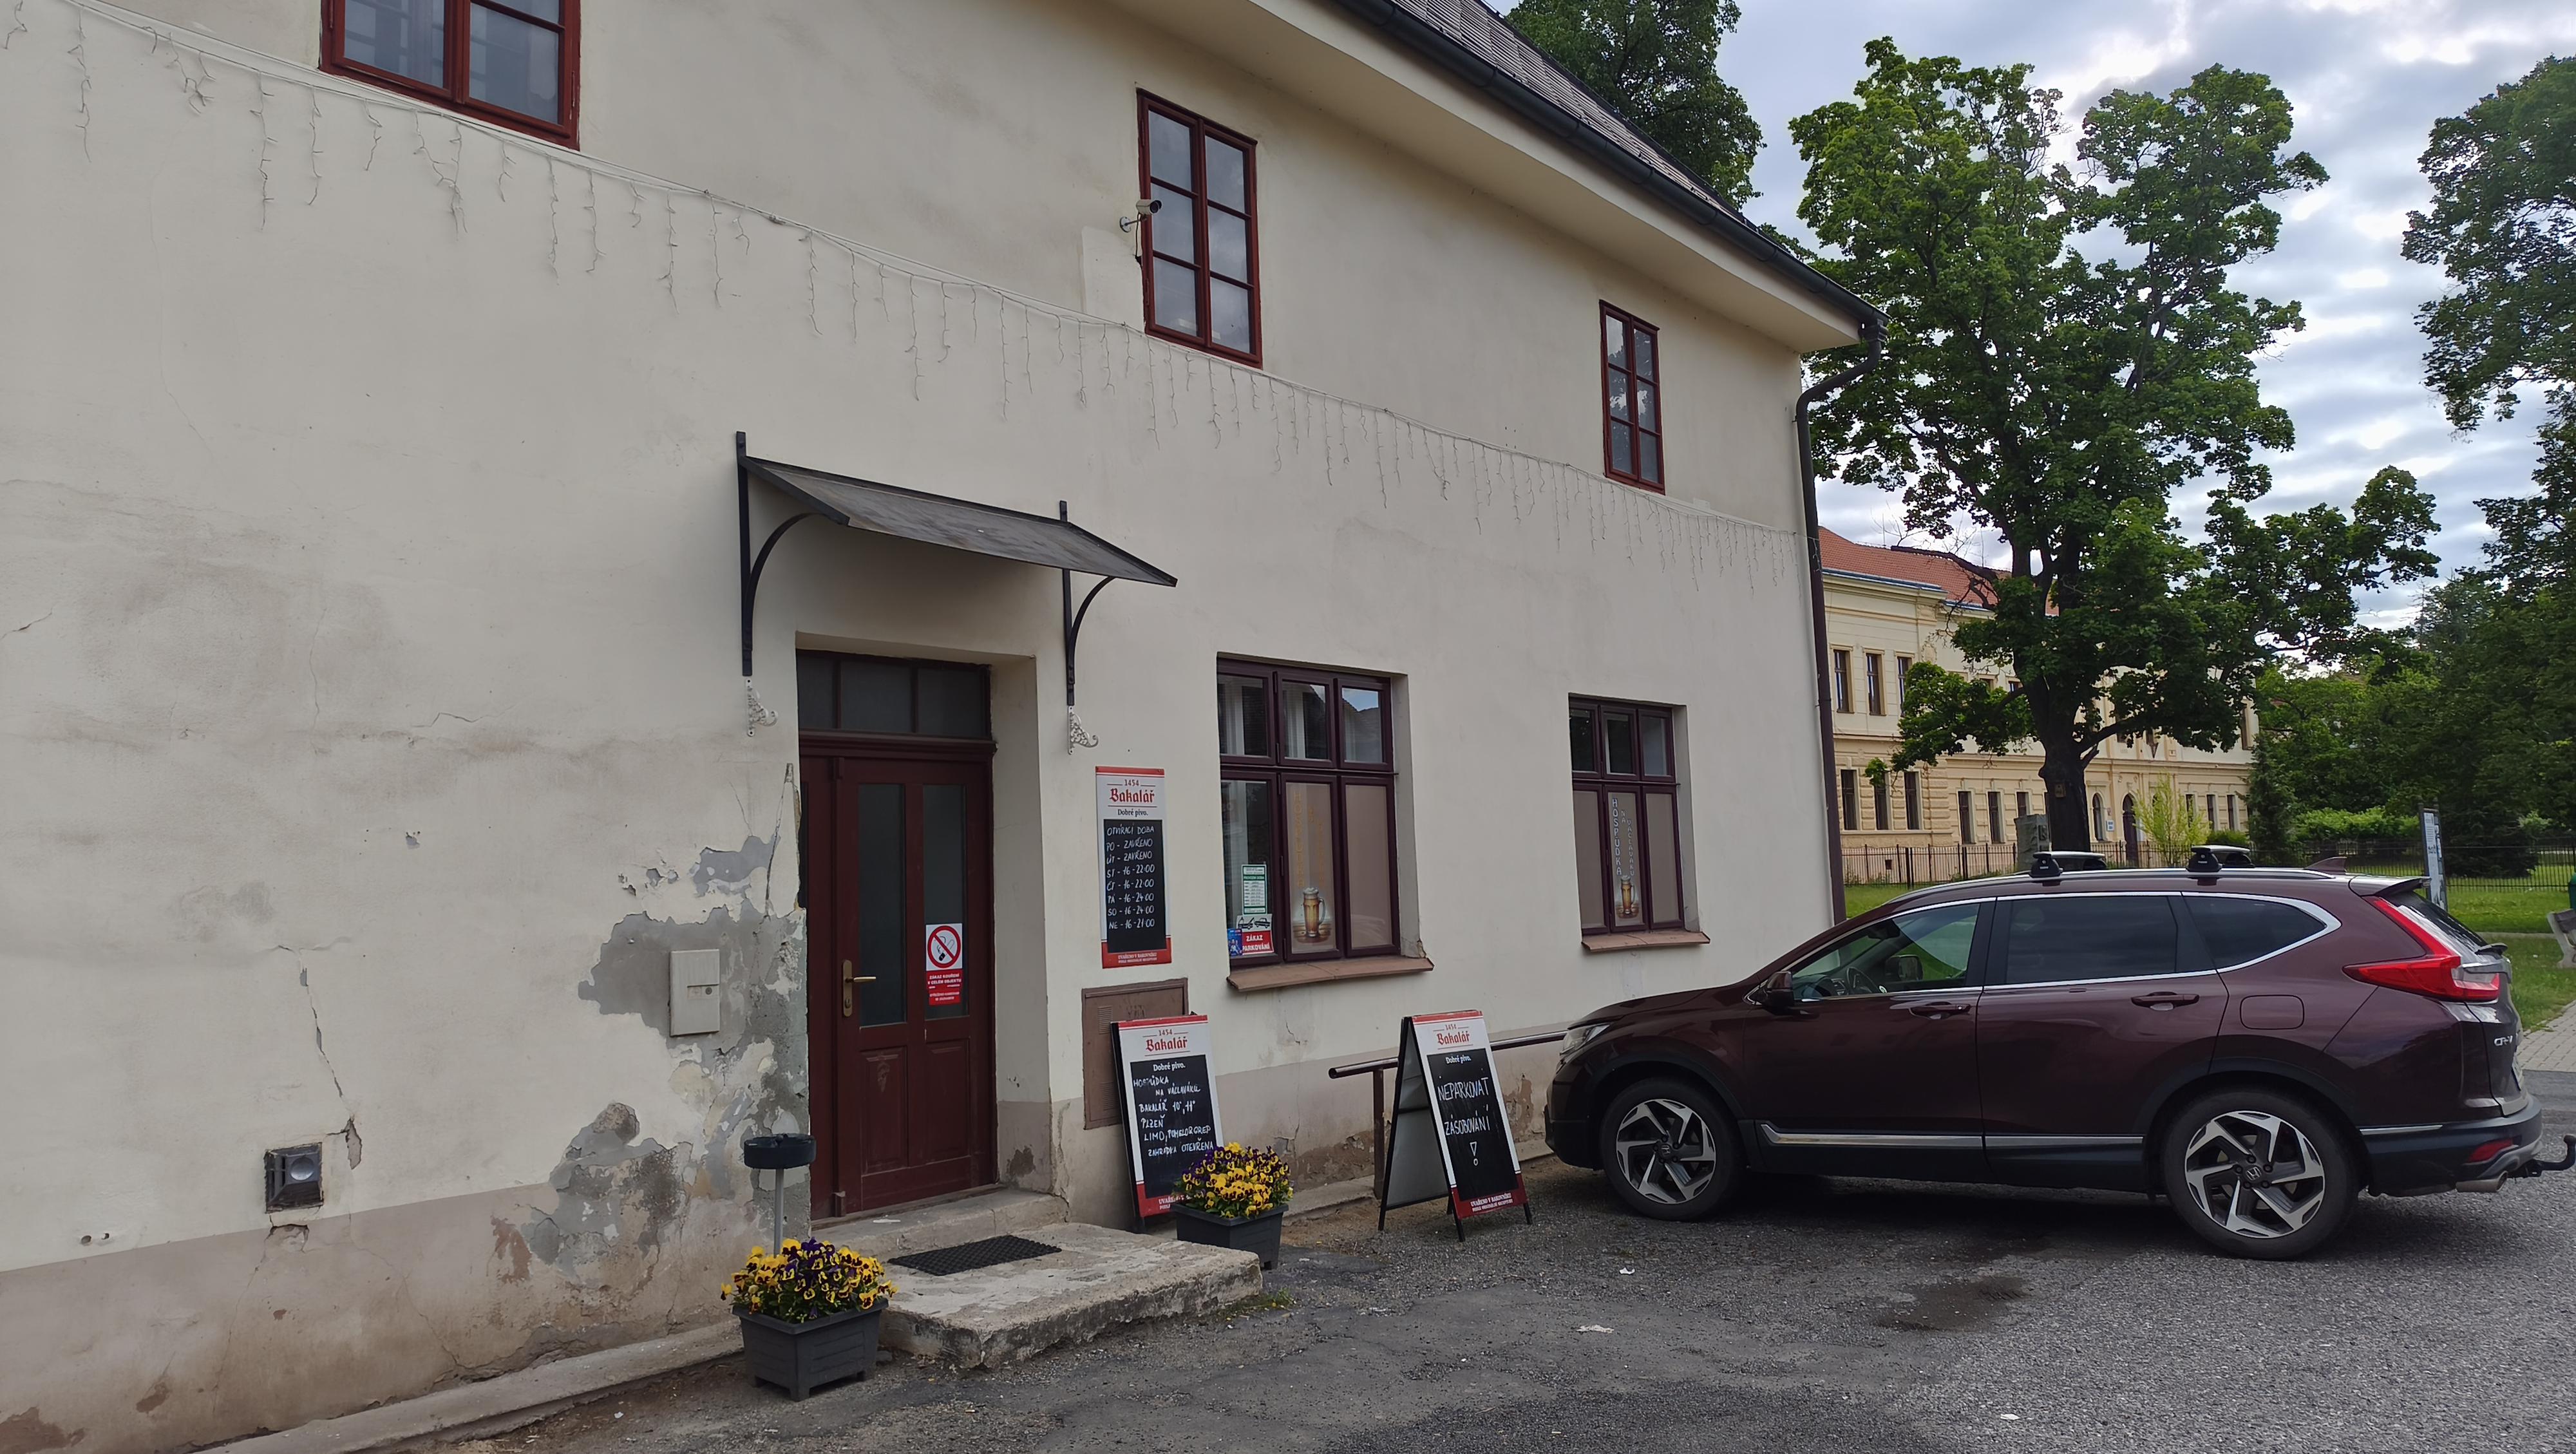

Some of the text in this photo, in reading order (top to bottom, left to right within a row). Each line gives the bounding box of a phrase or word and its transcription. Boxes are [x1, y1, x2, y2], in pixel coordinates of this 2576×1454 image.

[1110, 788, 1155, 803] Bakalář
[1135, 809, 1148, 817] pivo.
[1137, 826, 1155, 835] DOBA
[1106, 842, 1115, 851] PO
[1106, 854, 1115, 864] ÚT
[1124, 850, 1153, 862] ZAVŘENO
[1106, 869, 1115, 878] ST
[1106, 880, 1115, 891] ČT
[1108, 894, 1115, 903] PÁ
[1108, 908, 1117, 916] SO
[1437, 1030, 1470, 1045] Bakalář
[1146, 1036, 1188, 1052] Bakalář
[1446, 1054, 1472, 1064] Dobré pivo.
[1153, 1061, 1186, 1072] Dobré pivo.
[1437, 1077, 1488, 1101] NEPARKOVAT
[1139, 1099, 1168, 1113] BAKALÁŘ
[1141, 1114, 1165, 1128] PLZEŇ
[1444, 1104, 1490, 1136] ZÁSOBOVÁNÍ
[1181, 1138, 1214, 1152] OTEVŘENA
